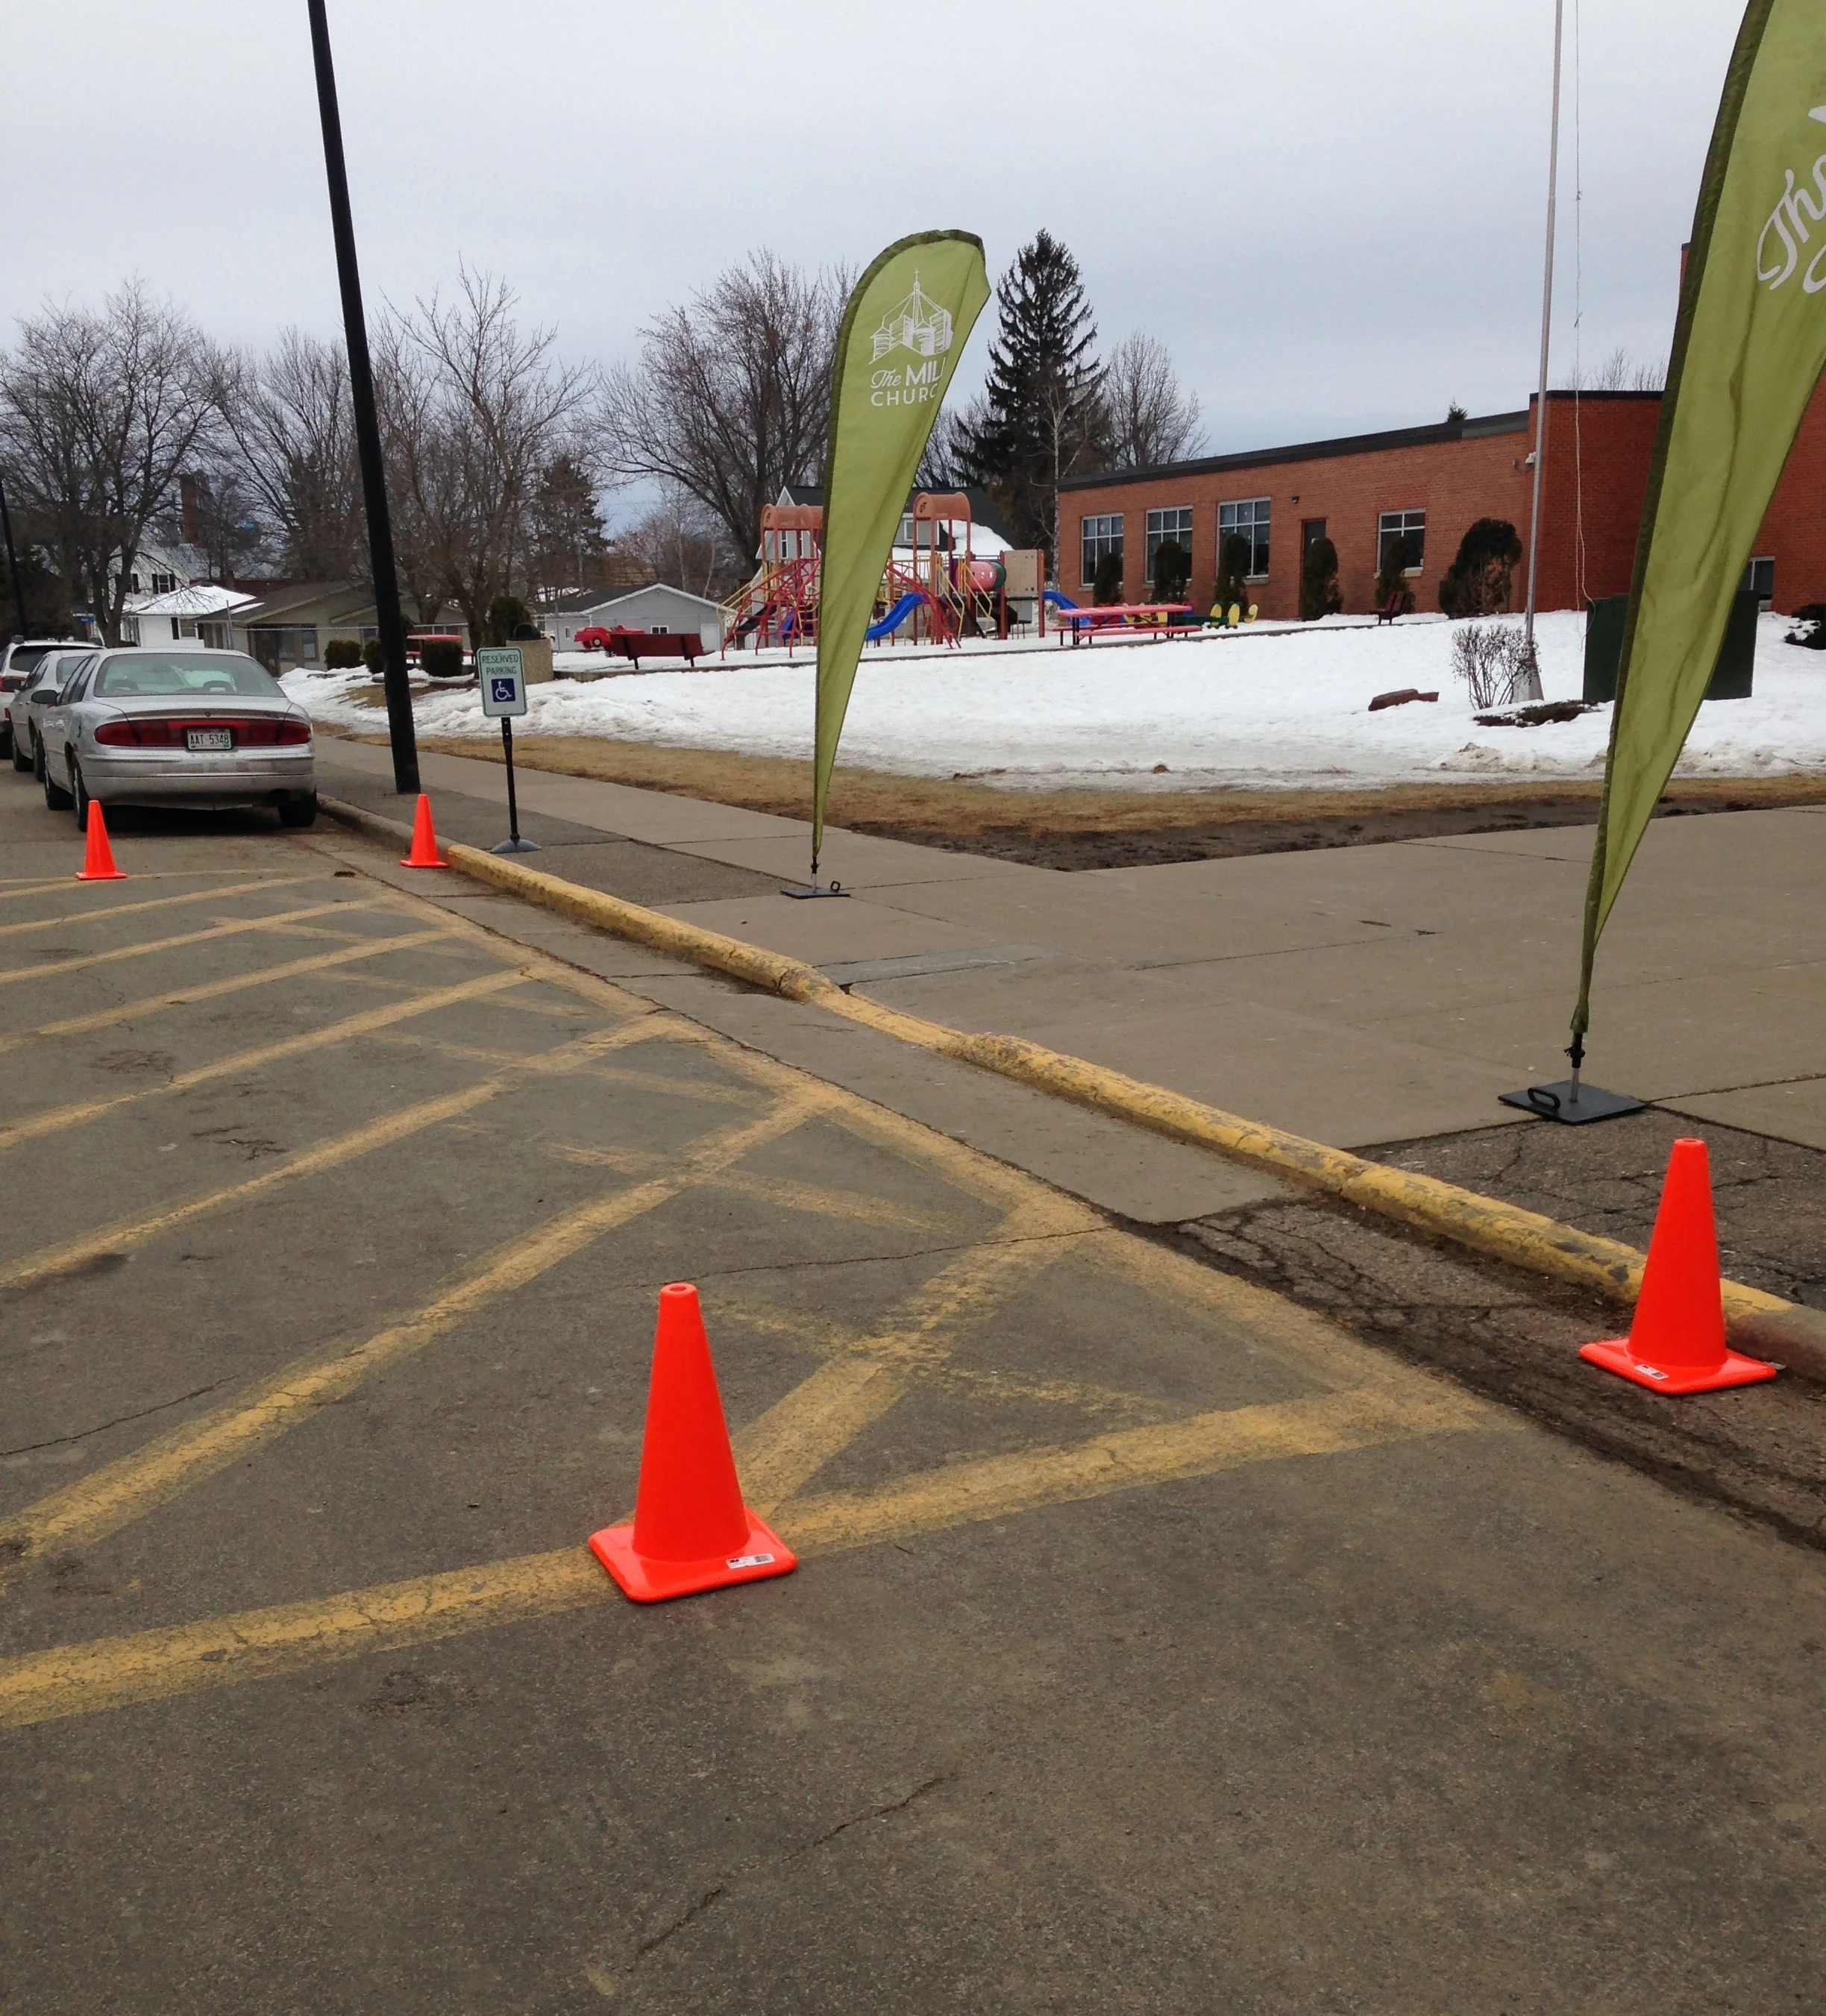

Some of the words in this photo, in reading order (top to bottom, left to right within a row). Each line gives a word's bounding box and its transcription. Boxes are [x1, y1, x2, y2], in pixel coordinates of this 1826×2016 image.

[870, 368, 901, 389] The
[482, 654, 519, 665] RESERVED
[486, 666, 517, 676] PARKING
[190, 734, 204, 745] AAT
